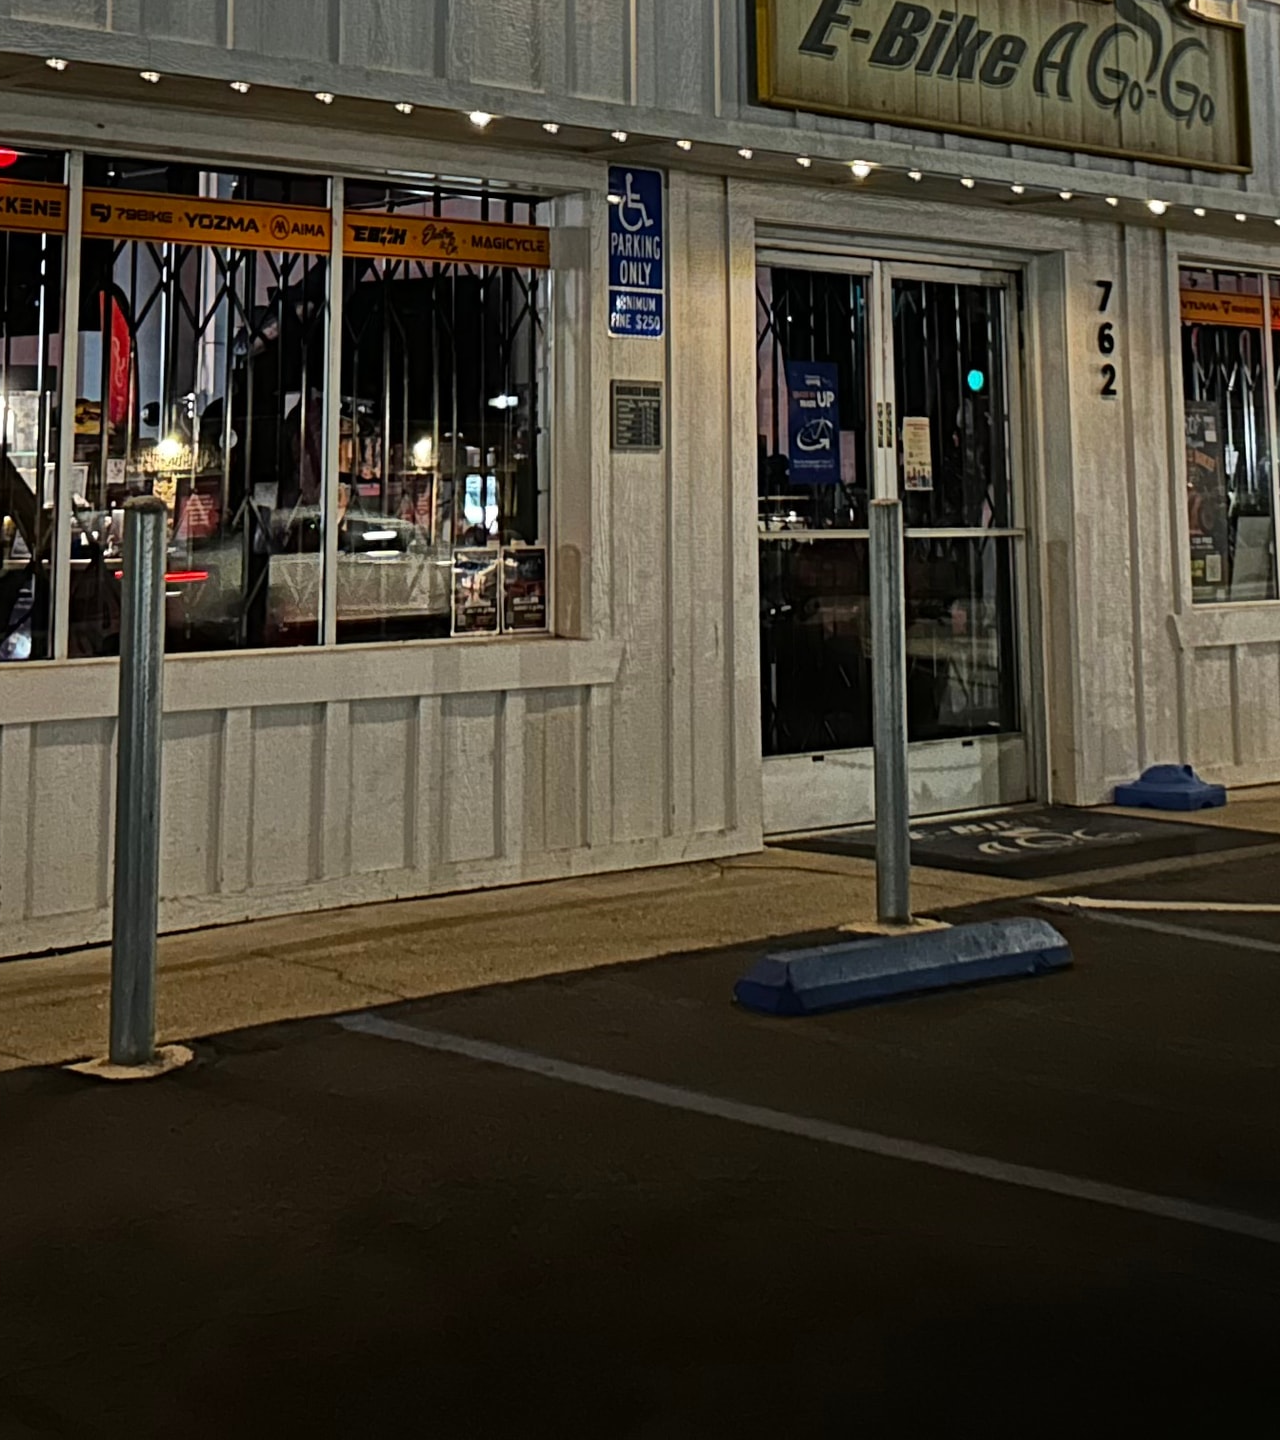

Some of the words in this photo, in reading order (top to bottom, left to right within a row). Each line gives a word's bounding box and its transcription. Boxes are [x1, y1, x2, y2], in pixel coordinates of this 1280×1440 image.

[184, 211, 259, 233] YOZMA
[291, 222, 325, 238] AIMA
[471, 234, 546, 253] MAGICYCLE
[610, 232, 661, 260] PARKING
[619, 260, 653, 286] ONLY
[610, 311, 632, 329] FINE
[635, 313, 661, 332] $250
[816, 390, 836, 409] UP
